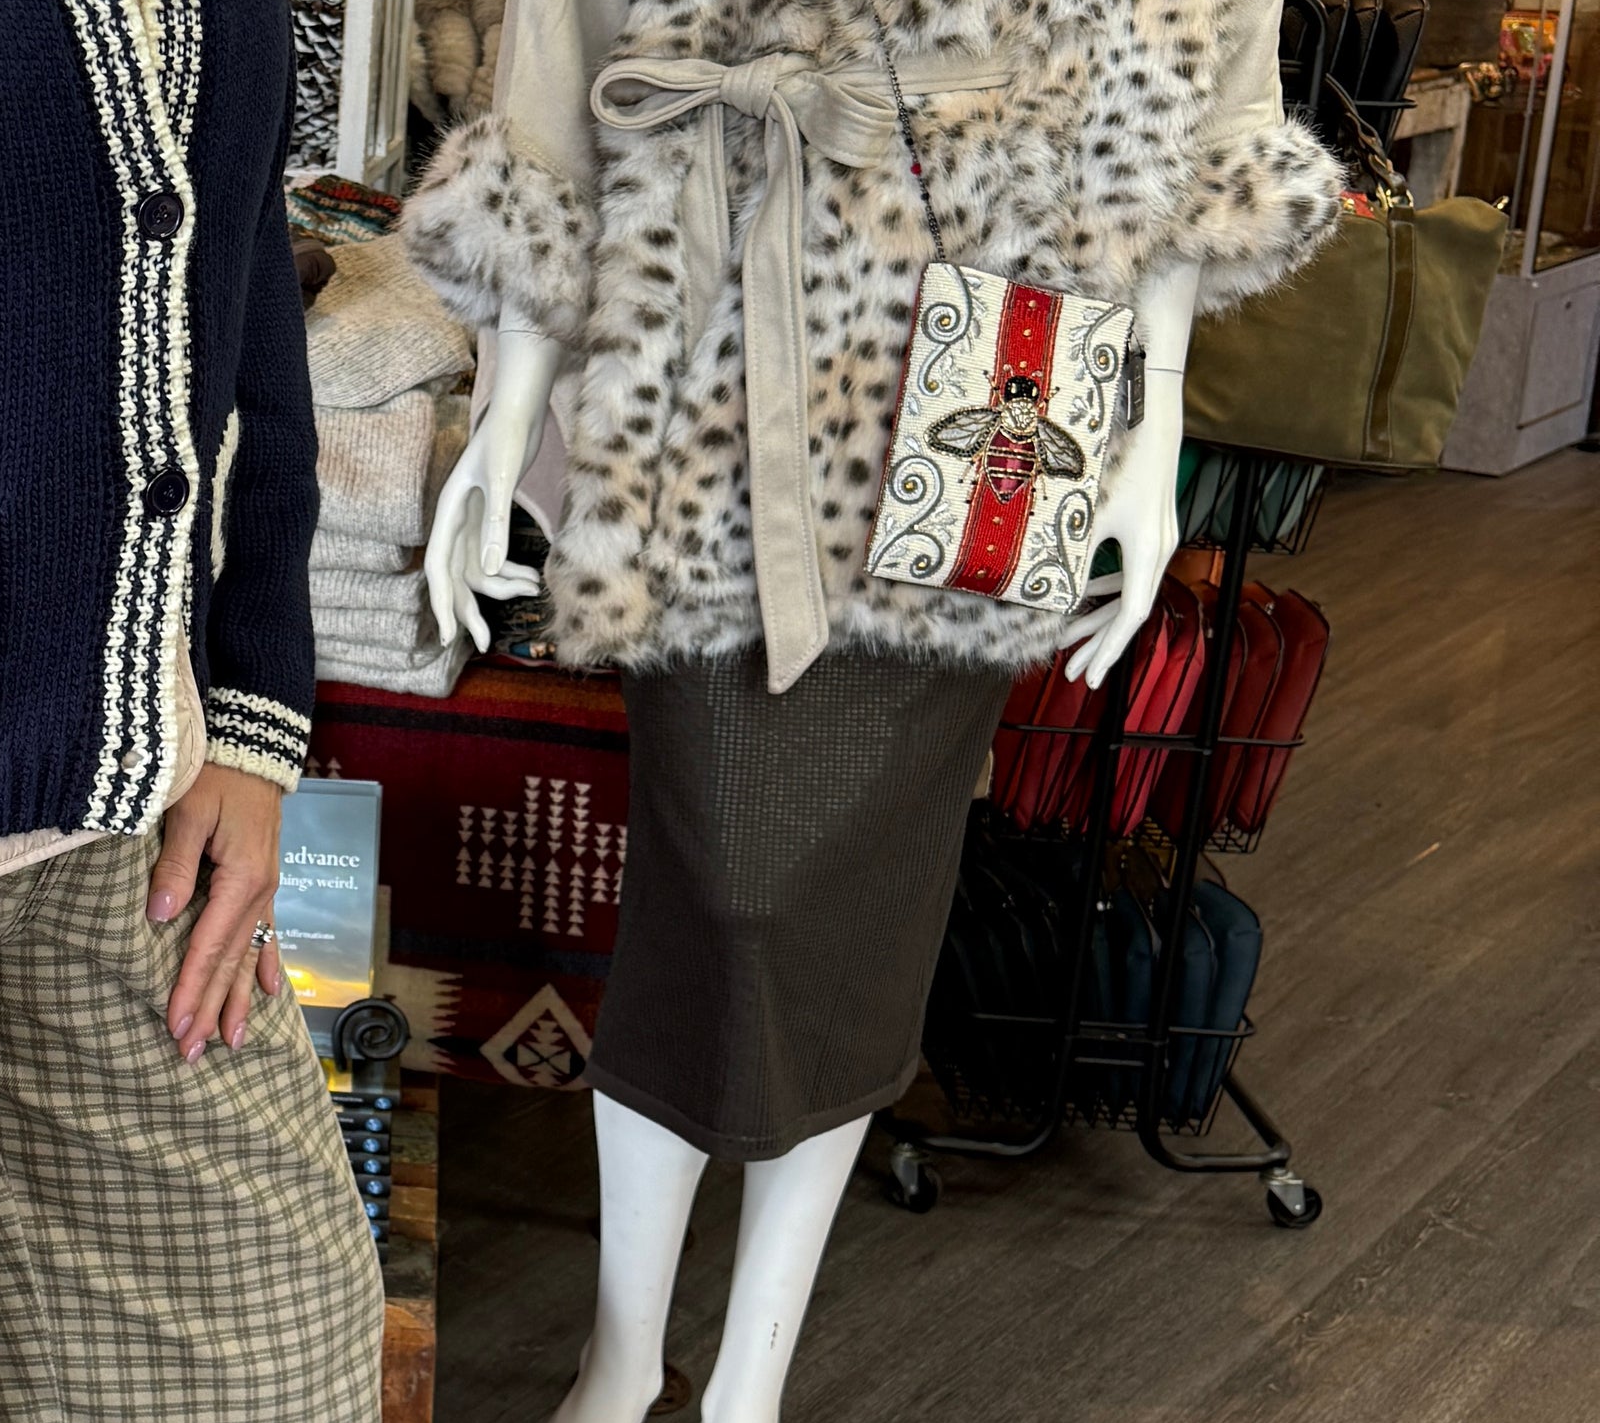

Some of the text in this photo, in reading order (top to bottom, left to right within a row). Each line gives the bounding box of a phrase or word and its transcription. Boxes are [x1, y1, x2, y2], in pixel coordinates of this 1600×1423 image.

[284, 846, 360, 868] advance
[280, 872, 359, 892] hings weird.
